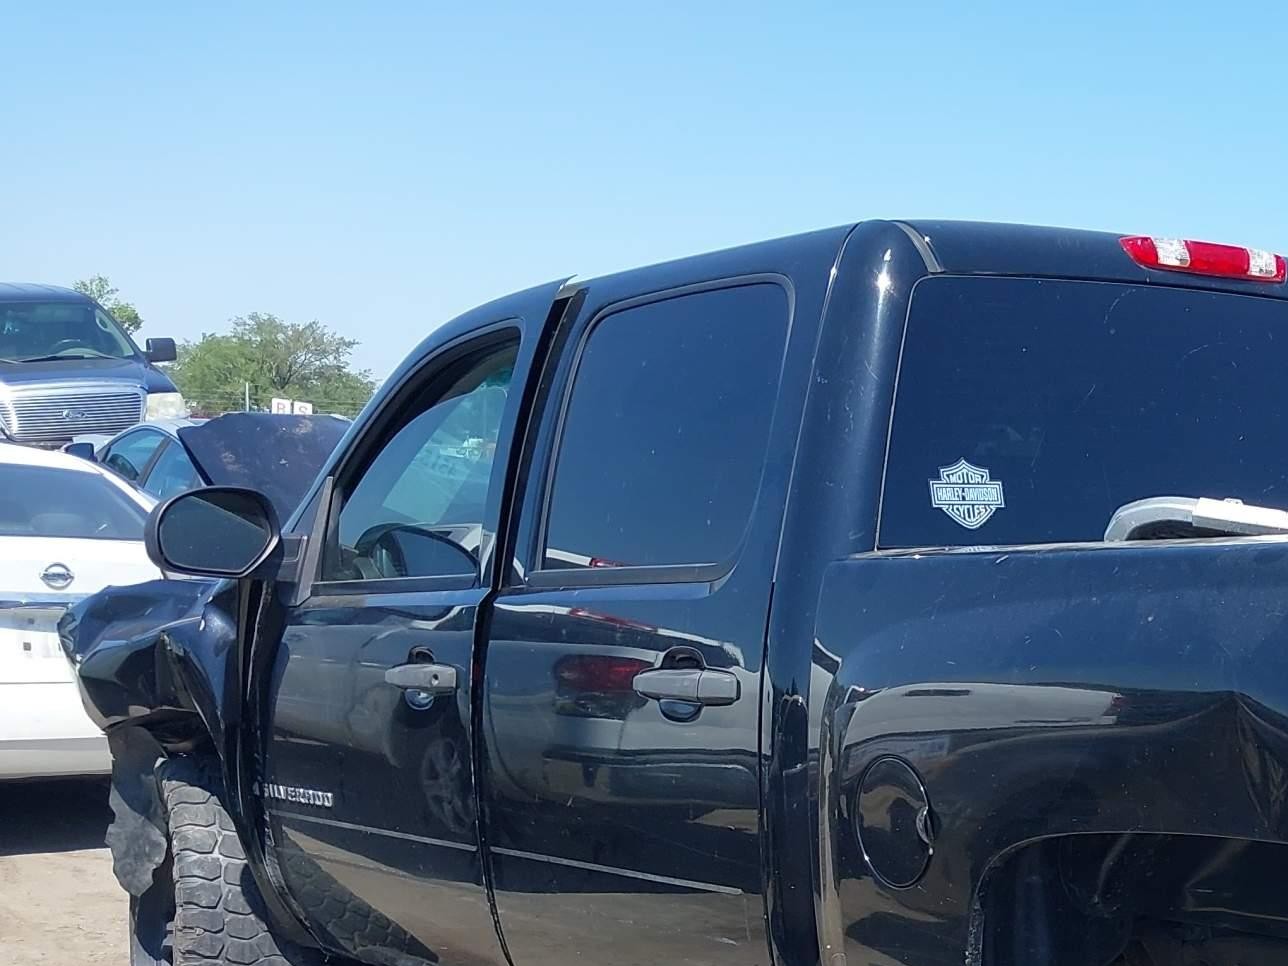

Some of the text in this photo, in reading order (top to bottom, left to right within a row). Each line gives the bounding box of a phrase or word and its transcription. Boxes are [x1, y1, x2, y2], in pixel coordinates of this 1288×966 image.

[949, 469, 982, 484] MOTOR
[937, 487, 998, 501] HARLEY-DAVIDSON
[953, 504, 987, 521] CYCLES
